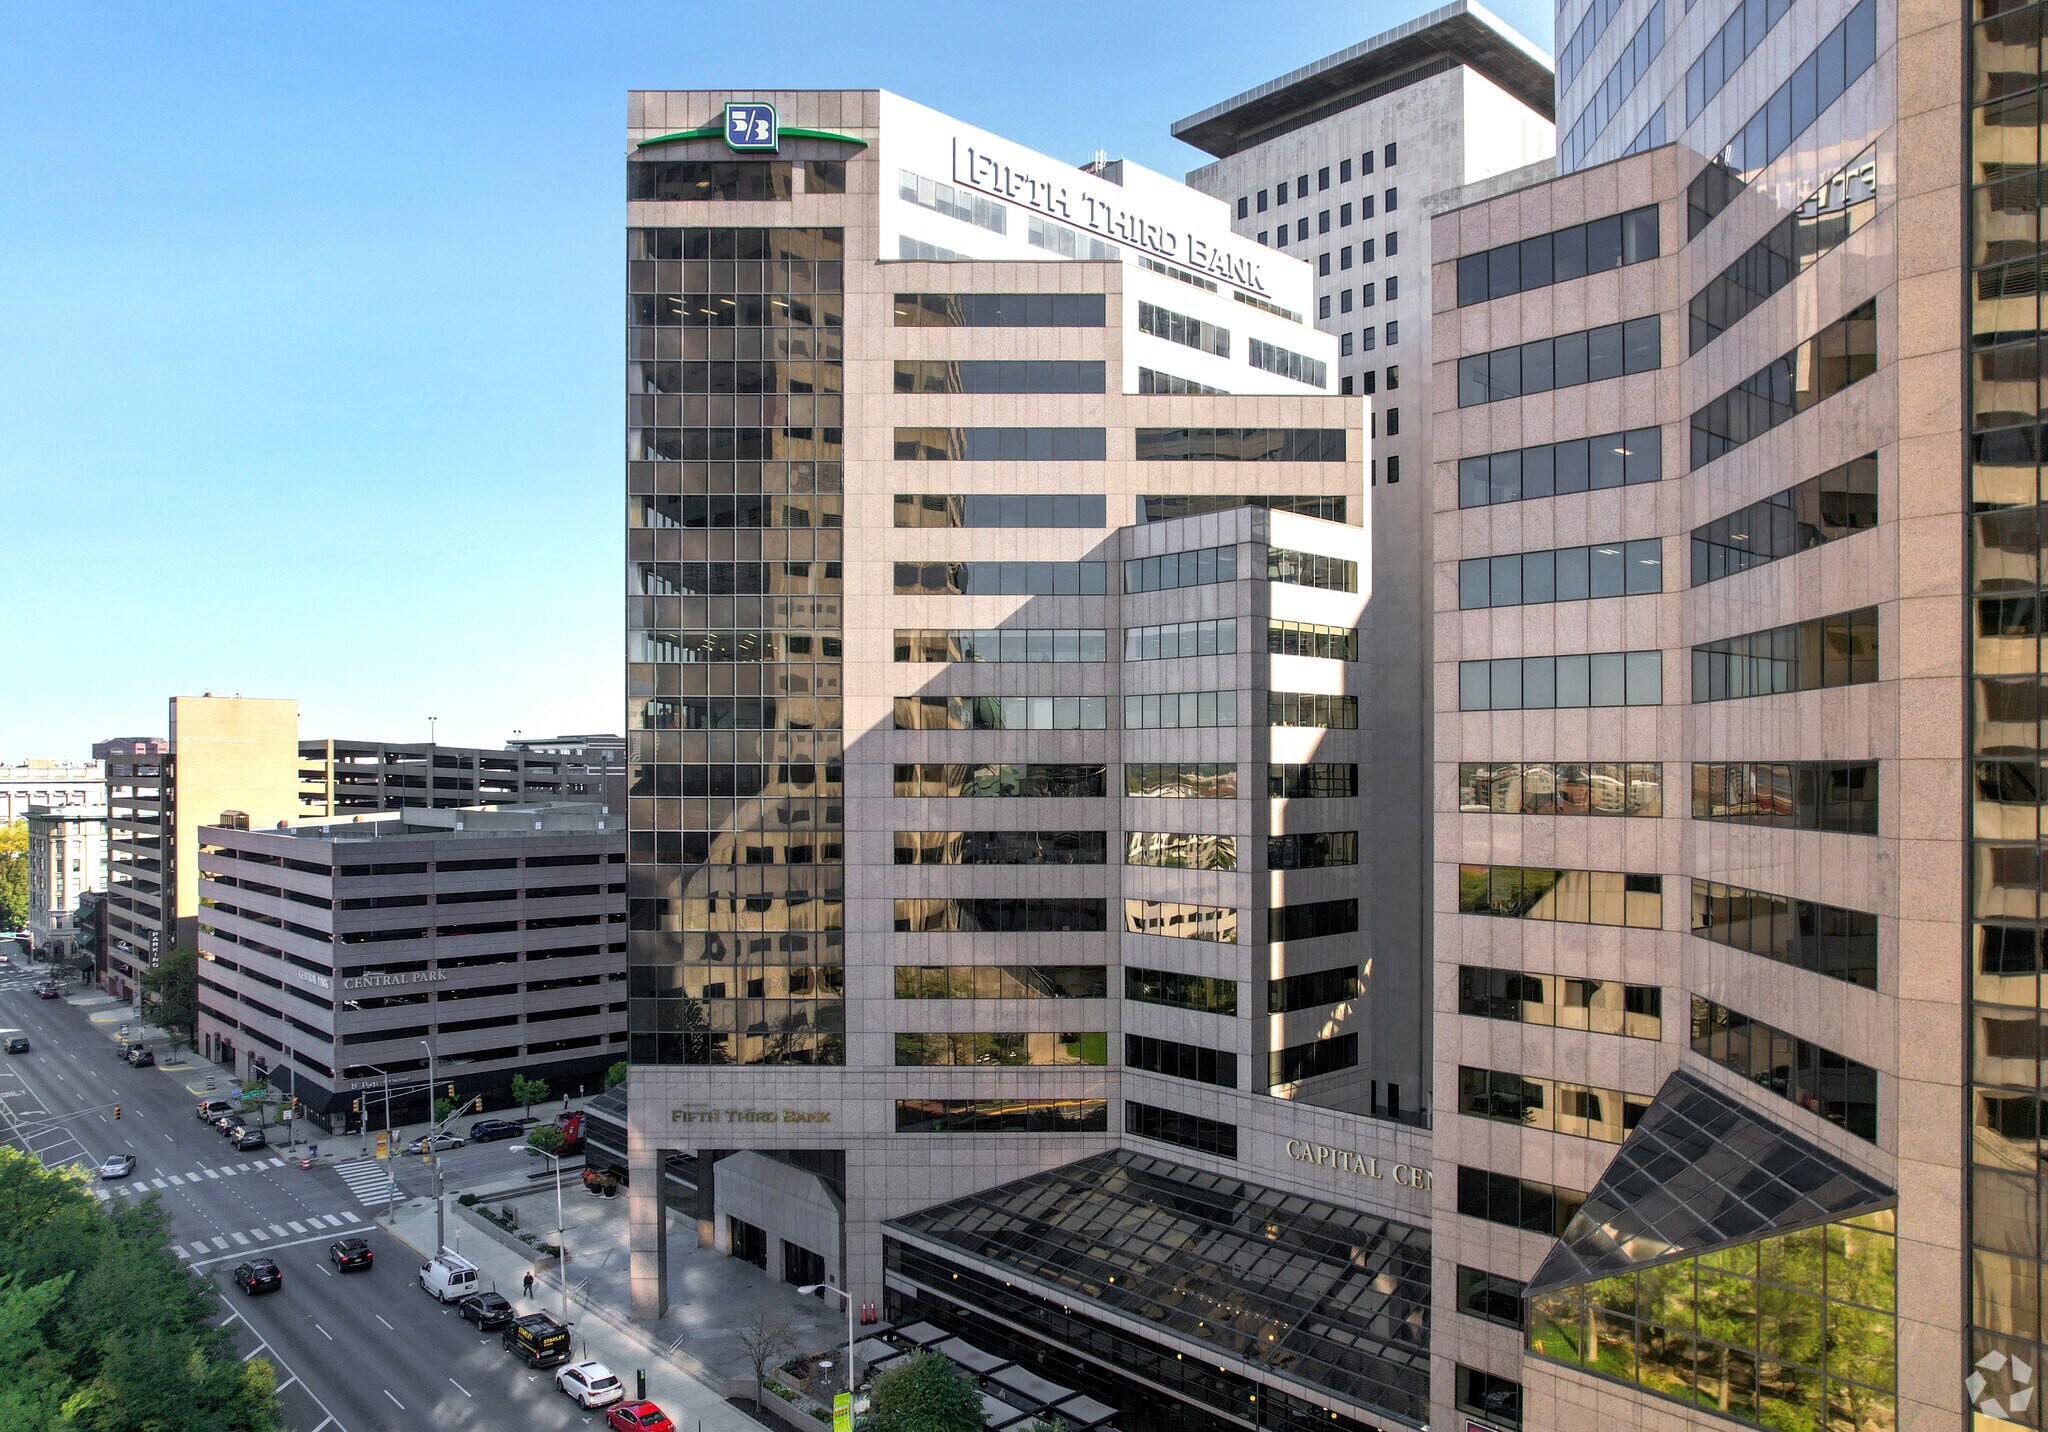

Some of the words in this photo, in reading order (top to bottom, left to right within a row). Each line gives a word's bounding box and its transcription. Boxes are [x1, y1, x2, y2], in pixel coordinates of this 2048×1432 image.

[731, 109, 770, 142] 5/3
[967, 146, 1072, 218] FIFTH
[1082, 191, 1177, 257] THIRD
[1187, 233, 1265, 291] BANK
[152, 931, 160, 968] PARKING
[344, 973, 409, 990] CENTRAL
[413, 969, 447, 983] PARK
[671, 1109, 720, 1123] FIFTH
[725, 1109, 778, 1123] THIRD
[783, 1109, 832, 1123] BANK
[1286, 1138, 1383, 1179] CAPITAL
[543, 1334, 566, 1344] STANLEY
